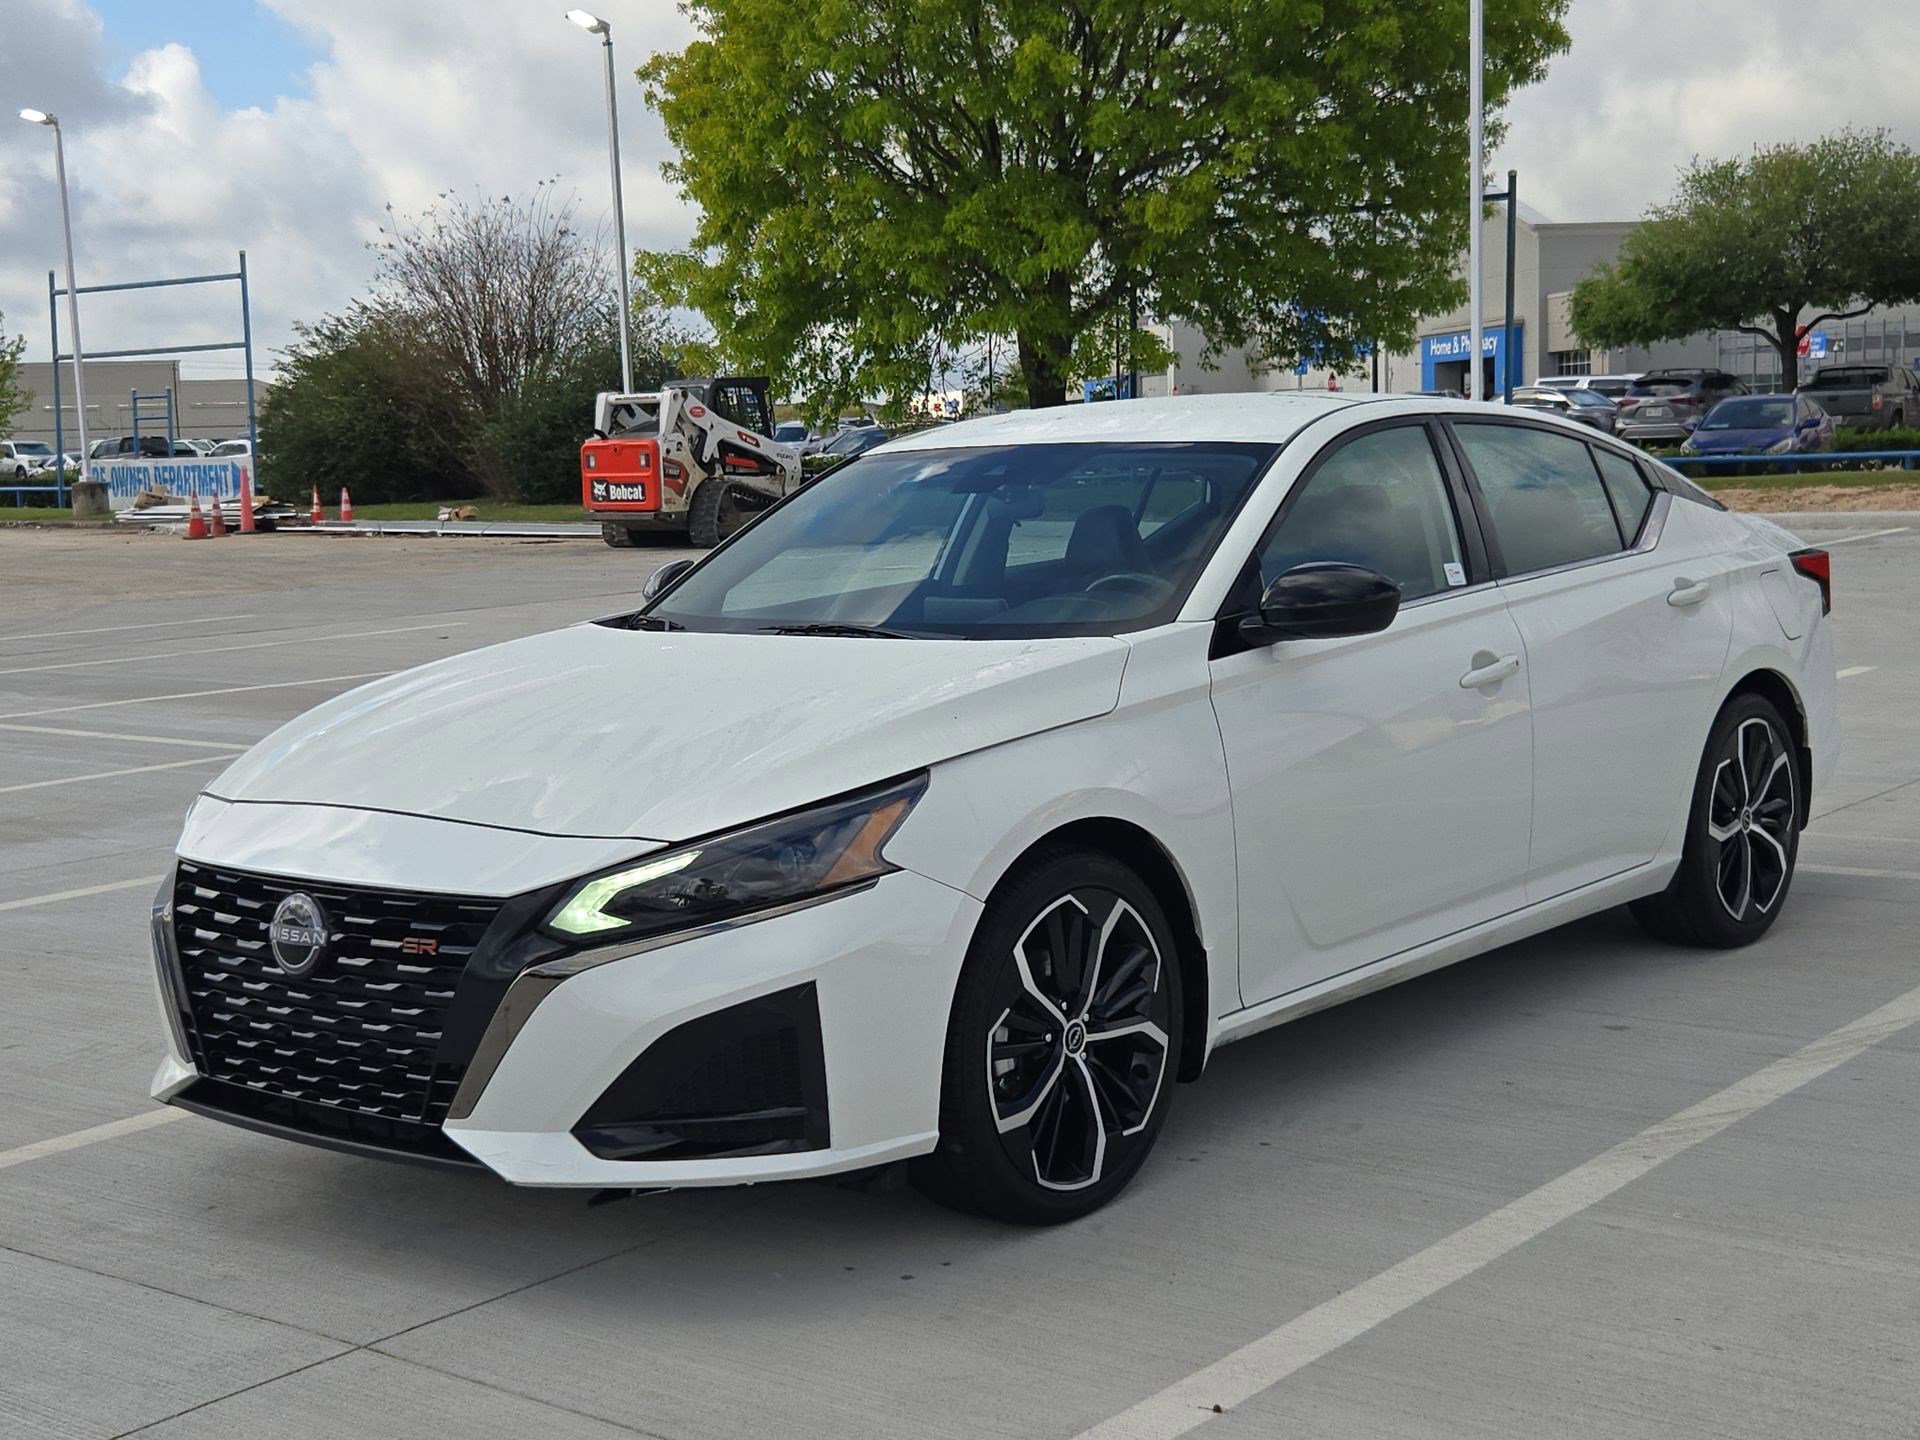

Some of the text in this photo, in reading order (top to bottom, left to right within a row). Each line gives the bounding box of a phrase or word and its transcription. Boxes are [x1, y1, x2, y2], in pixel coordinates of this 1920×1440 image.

[1430, 335, 1498, 356] Home & Phacy
[153, 464, 229, 497] DEPARTMENT
[608, 484, 643, 500] Bobcat
[271, 926, 326, 945] NISSAN
[402, 937, 437, 956] SR
